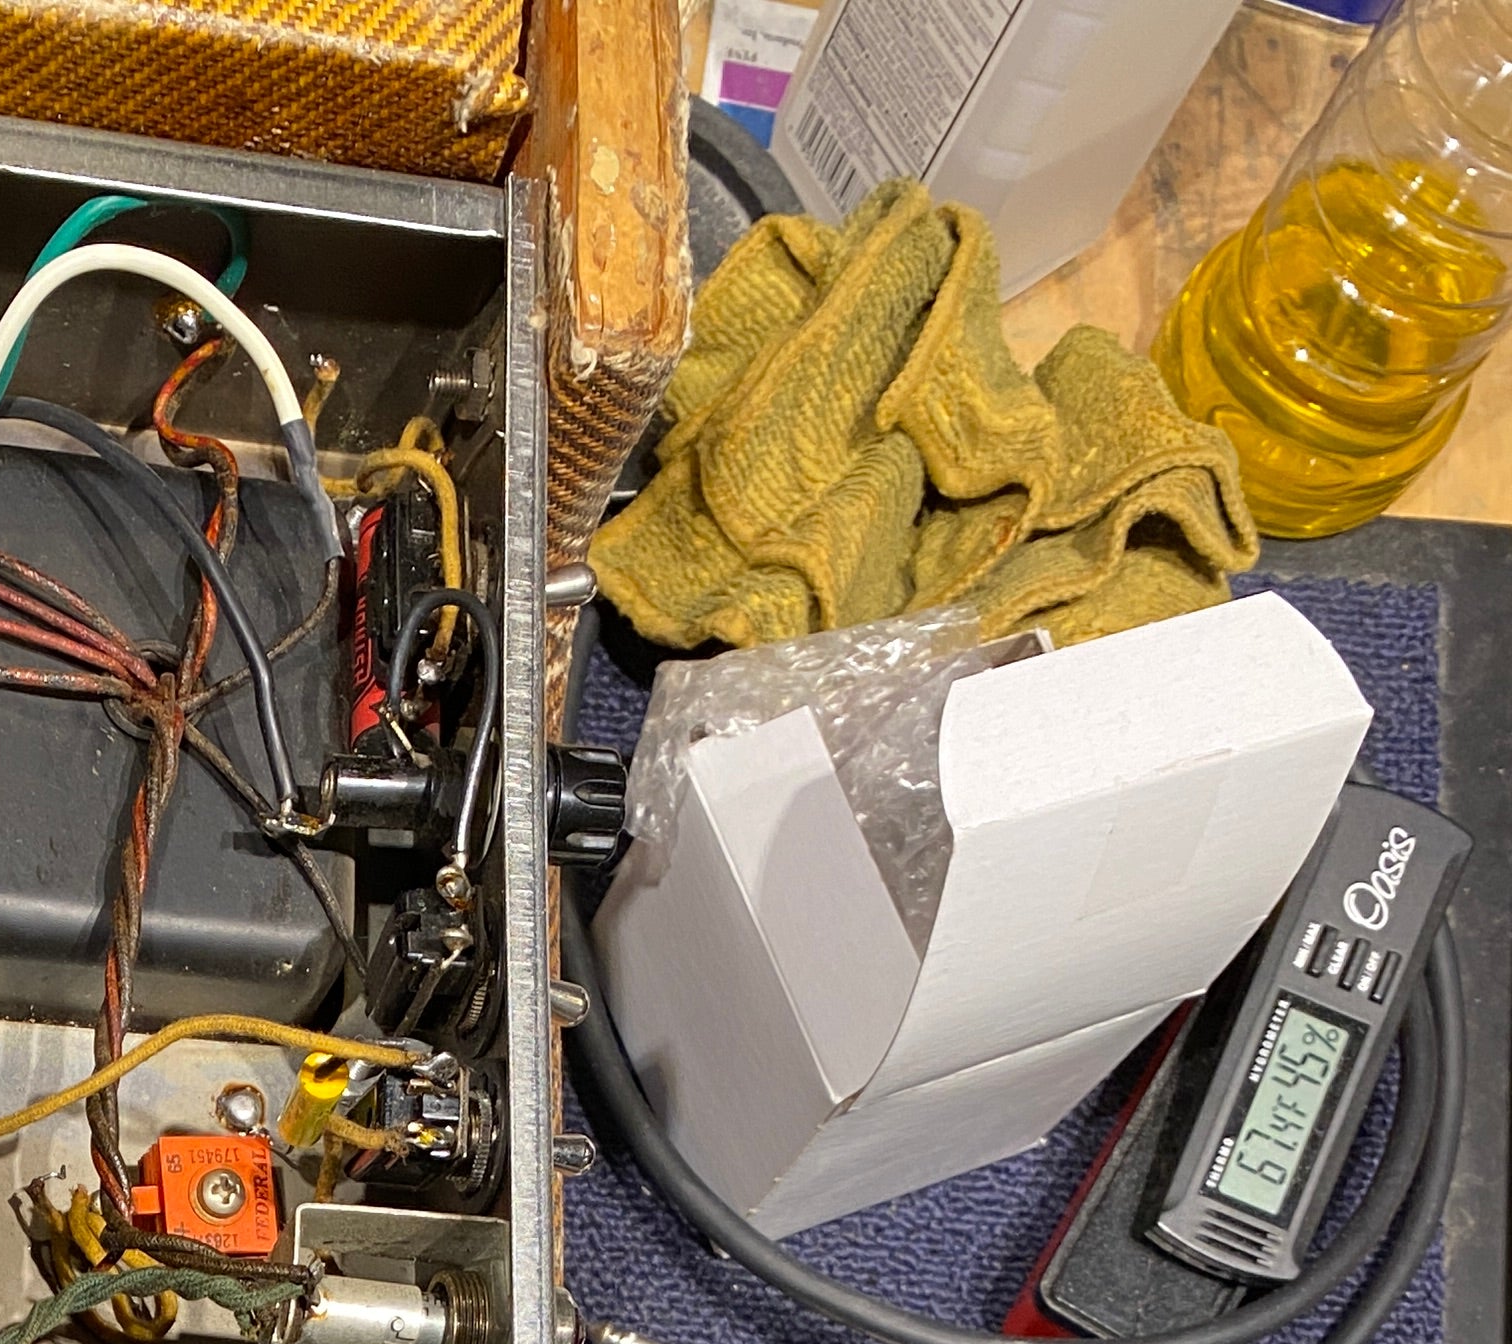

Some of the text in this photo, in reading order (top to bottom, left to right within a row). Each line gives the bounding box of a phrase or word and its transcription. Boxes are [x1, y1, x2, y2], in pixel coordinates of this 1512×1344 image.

[1343, 826, 1416, 930] Oasis
[1327, 939, 1349, 976] CLEAR
[1205, 999, 1291, 1188] THERMO HYGROMETER
[189, 1147, 241, 1164] 179451
[251, 1148, 272, 1242] FEDERAL
